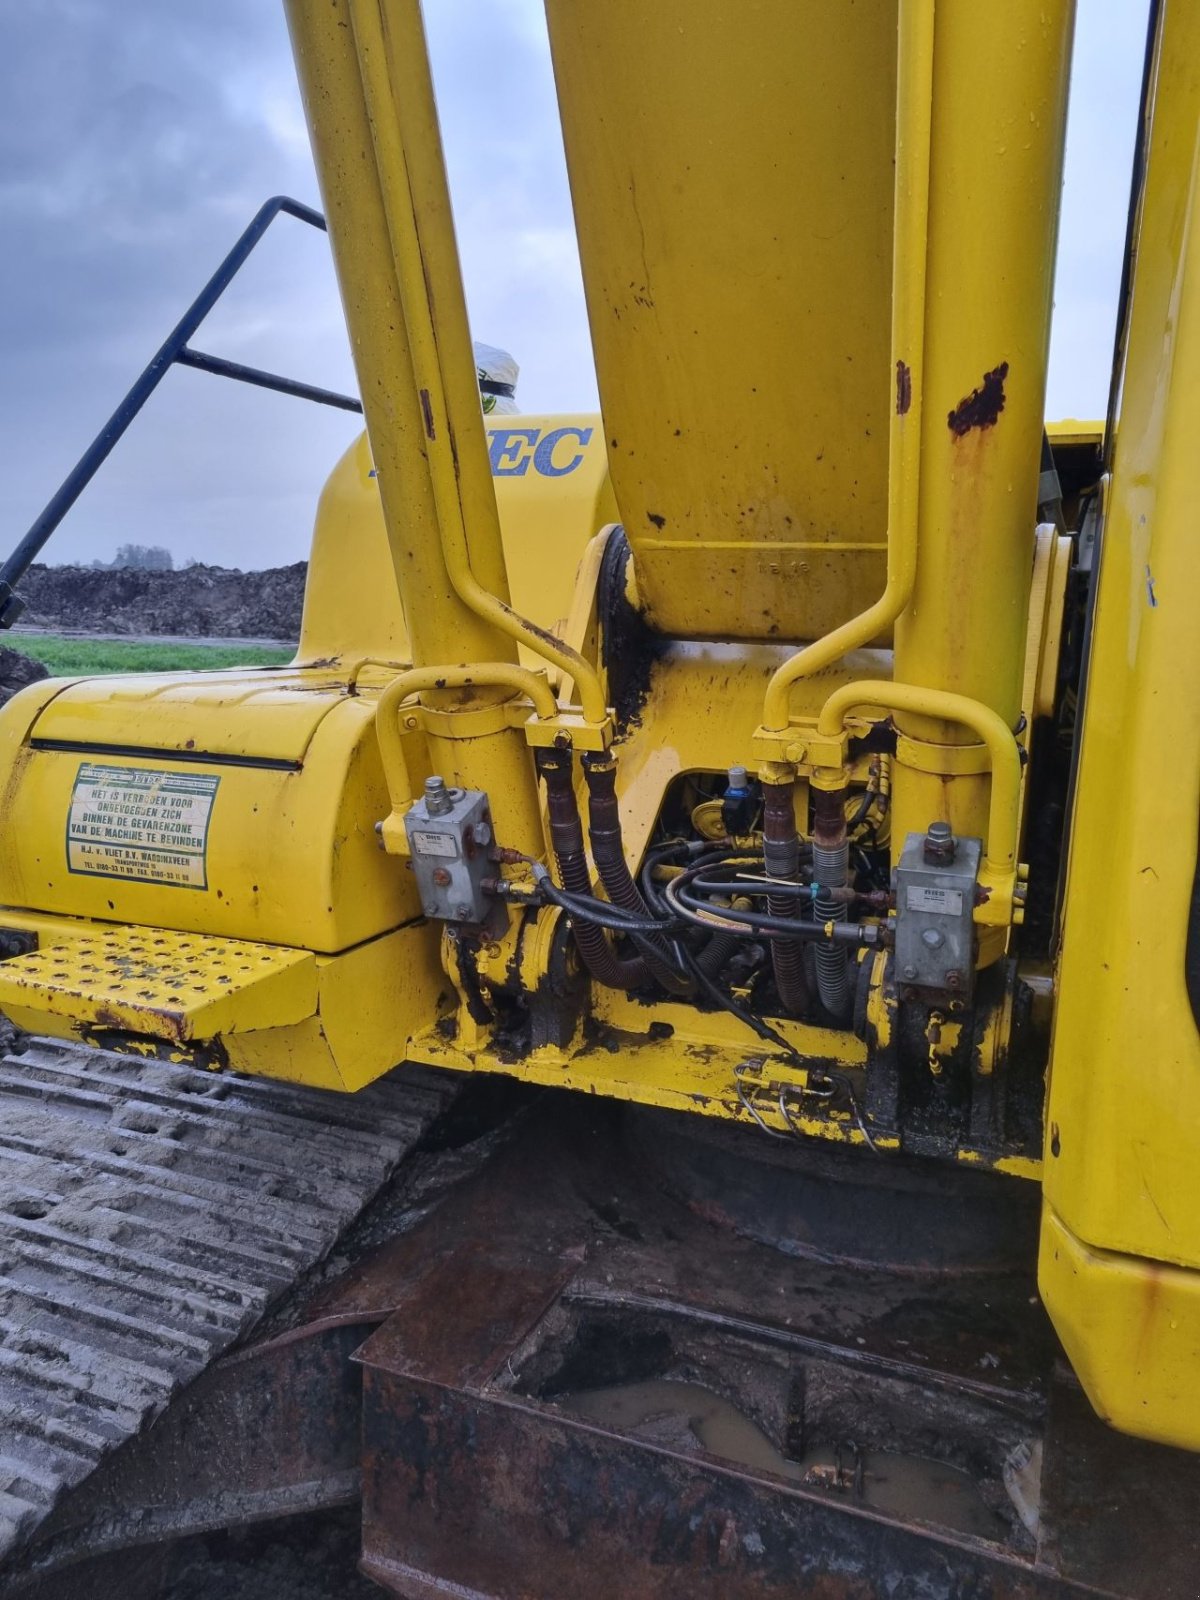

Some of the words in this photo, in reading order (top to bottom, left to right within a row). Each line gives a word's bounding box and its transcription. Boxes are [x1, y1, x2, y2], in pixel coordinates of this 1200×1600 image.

[91, 789, 107, 800] HET
[109, 790, 119, 801] IS
[170, 797, 193, 809] VOOR
[82, 813, 113, 825] BINNEN
[117, 816, 128, 827] DE
[131, 818, 193, 834] GEVARENZONE
[161, 809, 182, 820] ZICH
[71, 823, 87, 834] VAN
[90, 826, 101, 837] DE
[104, 828, 143, 841] MACHINE
[146, 832, 156, 842] TE
[160, 834, 203, 848] BEVINDEN
[105, 848, 123, 858] VLIET
[125, 850, 138, 860] B.V.
